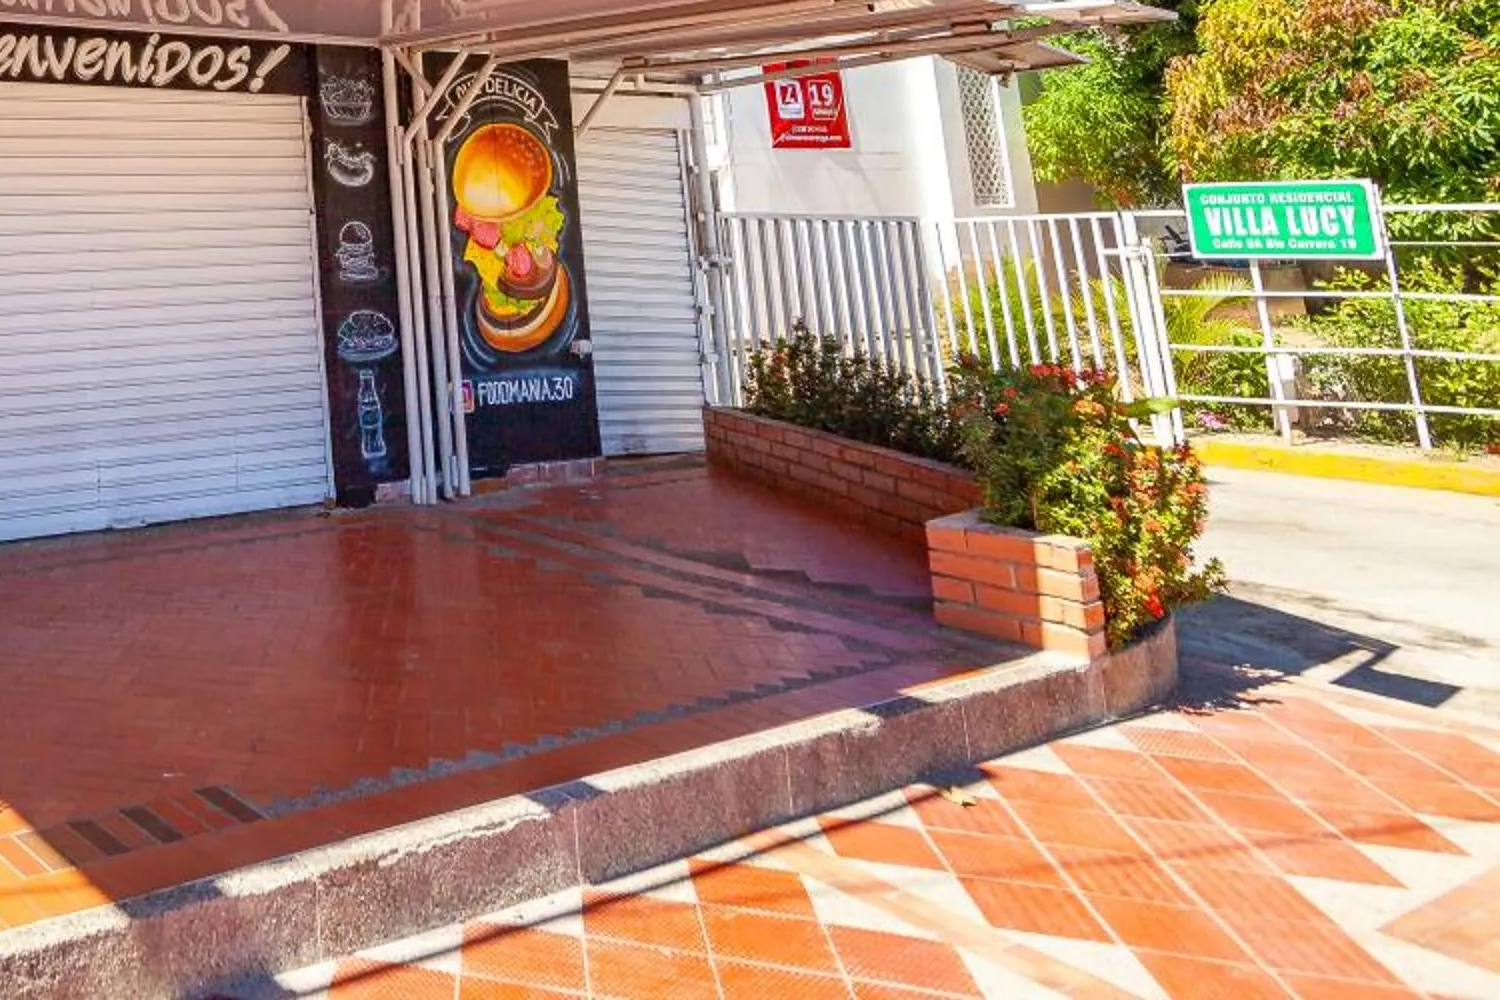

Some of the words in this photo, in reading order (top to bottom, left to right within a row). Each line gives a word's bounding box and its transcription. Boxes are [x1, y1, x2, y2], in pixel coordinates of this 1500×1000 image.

[485, 77, 537, 111] DELICIA
[810, 83, 834, 107] 19
[1200, 193, 1265, 205] CONJUNTO
[1268, 191, 1355, 204] RESIDENCIAL
[1203, 206, 1280, 237] VILLA
[1284, 205, 1356, 237] LUCY
